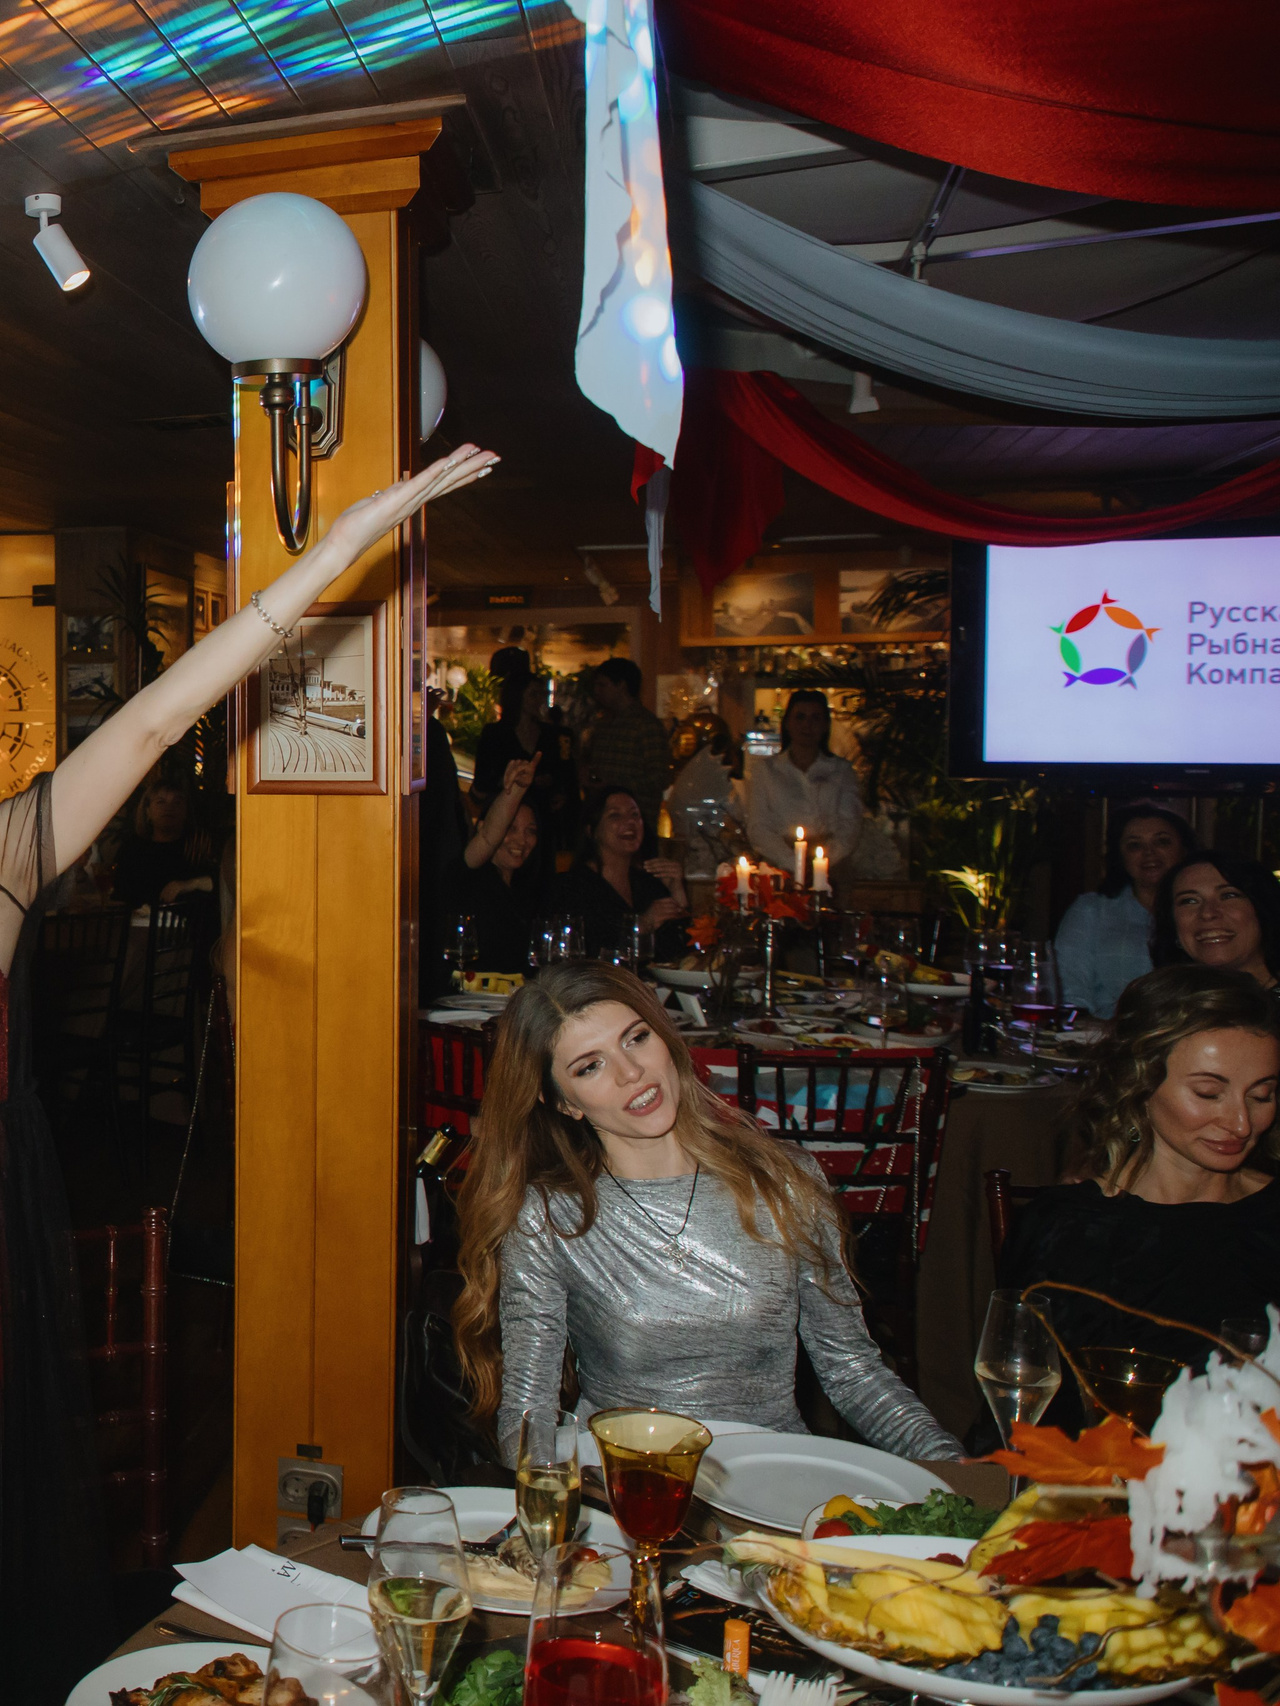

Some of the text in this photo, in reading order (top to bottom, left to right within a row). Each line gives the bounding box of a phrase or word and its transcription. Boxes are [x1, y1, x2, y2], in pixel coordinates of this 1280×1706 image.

[1188, 601, 1280, 629] Русск
[1187, 632, 1280, 655] Рыбна
[1187, 662, 1280, 685] Компа
